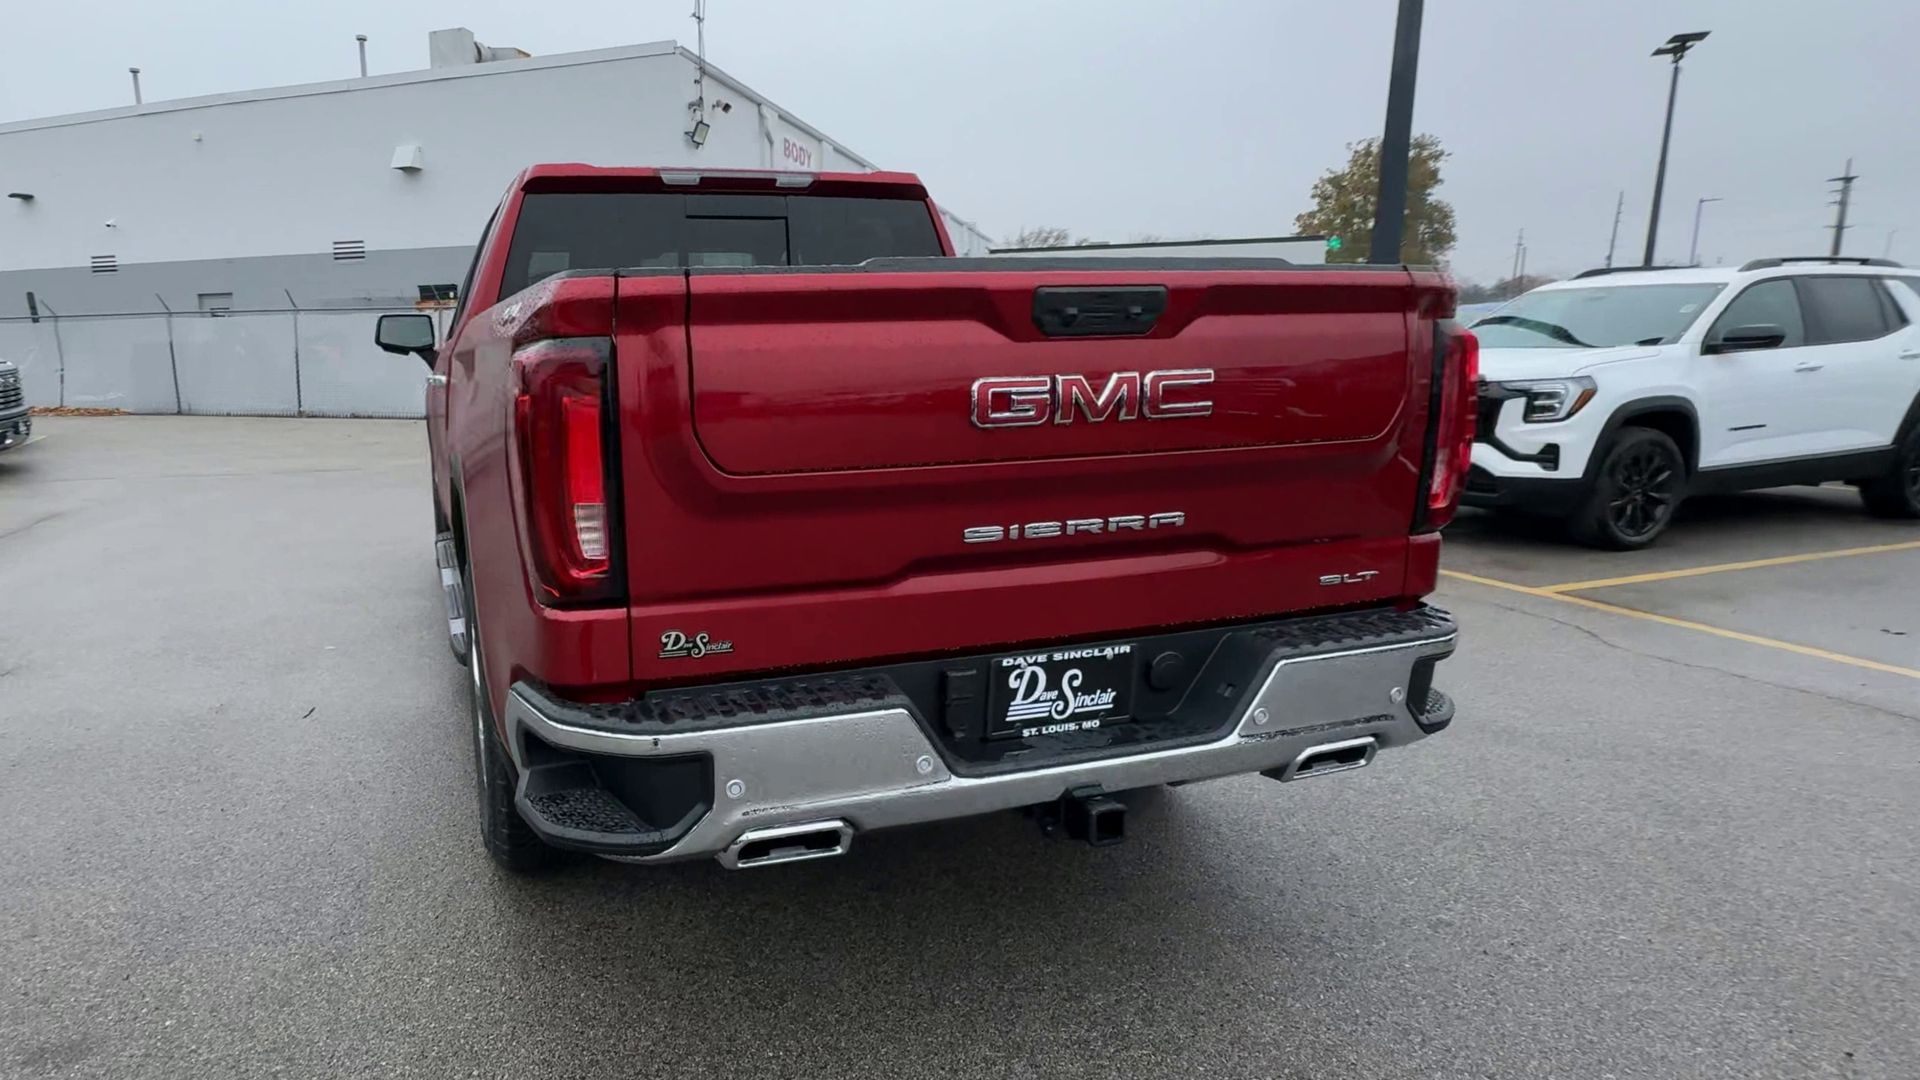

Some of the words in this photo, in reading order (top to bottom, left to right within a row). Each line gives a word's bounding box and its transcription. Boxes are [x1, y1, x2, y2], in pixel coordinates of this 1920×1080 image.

[784, 137, 812, 168] BODY
[971, 368, 1215, 428] GMC
[963, 511, 1185, 544] SIERRA
[1319, 570, 1380, 586] SLT
[1002, 654, 1047, 667] DAVE
[1052, 645, 1131, 661] SINCLAIR
[1008, 665, 1059, 705] Dave
[1051, 668, 1117, 720] Sinclair
[1022, 727, 1040, 738] ST.
[1082, 718, 1100, 730] MO
